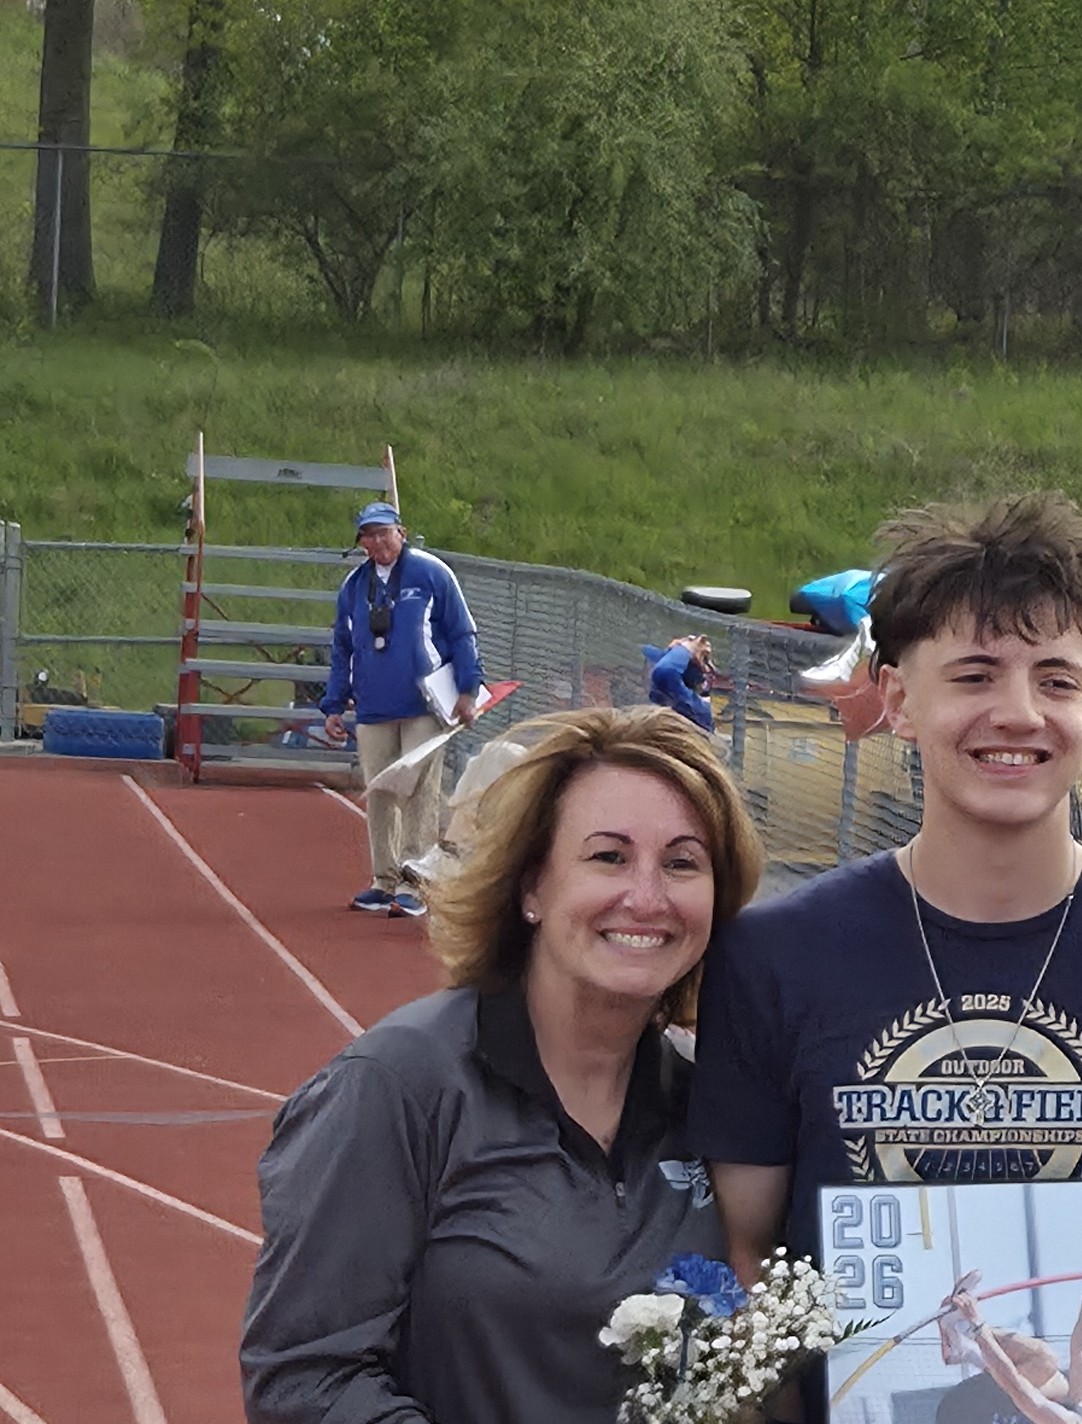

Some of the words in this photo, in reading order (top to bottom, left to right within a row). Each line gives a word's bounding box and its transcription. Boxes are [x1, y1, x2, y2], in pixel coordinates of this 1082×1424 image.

[961, 994, 1011, 1012] 2025
[941, 1059, 1025, 1075] OUTDOOR
[836, 1088, 970, 1123] TRACK
[874, 1129, 930, 1143] STATE
[831, 1194, 902, 1249] 20
[833, 1254, 904, 1310] 26
